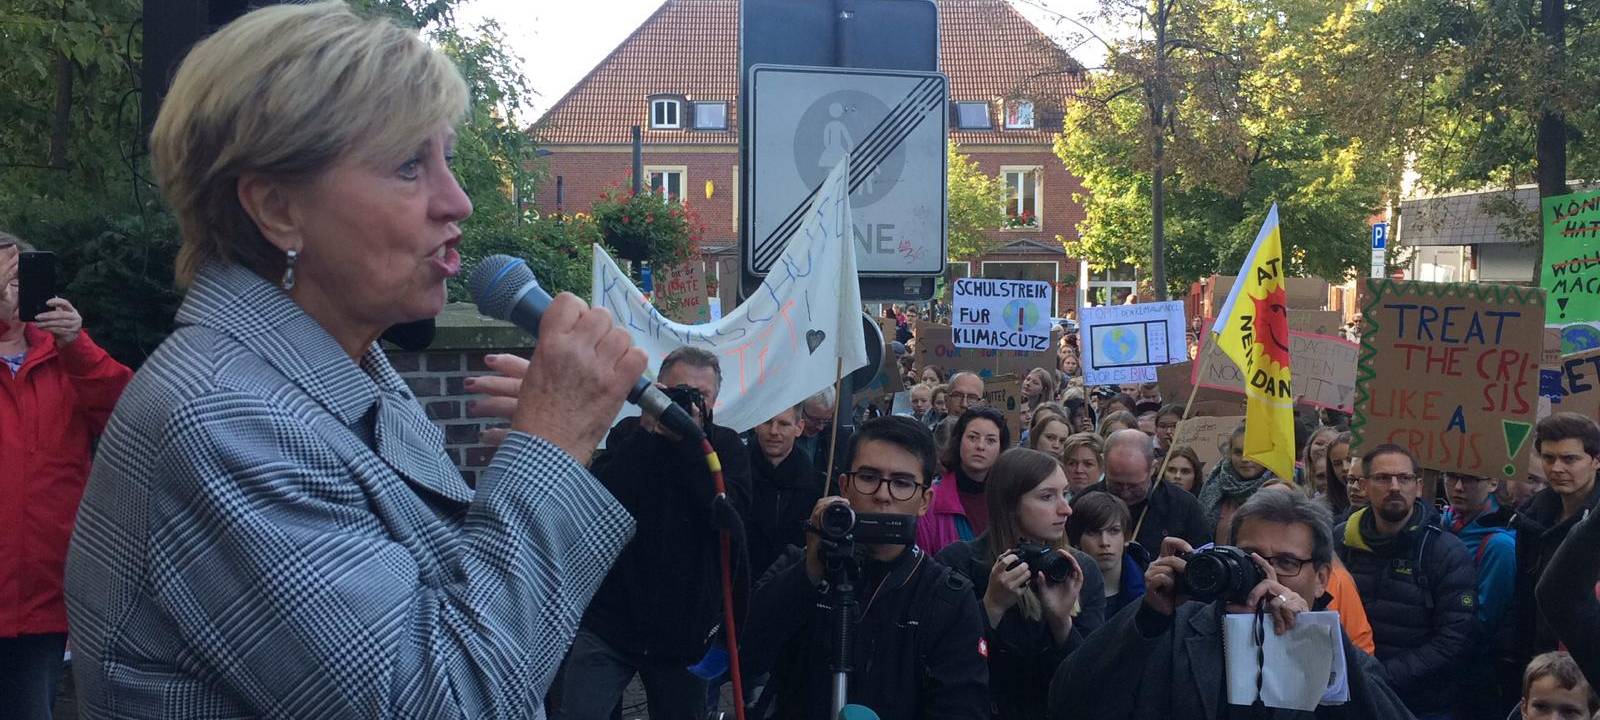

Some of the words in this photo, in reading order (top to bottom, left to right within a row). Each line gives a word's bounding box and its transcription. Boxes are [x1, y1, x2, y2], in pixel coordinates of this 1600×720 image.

[852, 223, 896, 255] NE
[1375, 226, 1383, 247] P
[956, 280, 1048, 299] SCHULSTREIK
[953, 328, 1049, 350] KLIMASCUTZ
[1384, 304, 1521, 345] TREAT
[1394, 344, 1469, 376] THE
[1370, 387, 1443, 420] LIKE
[1447, 404, 1466, 434] A
[1482, 382, 1531, 414] SIS
